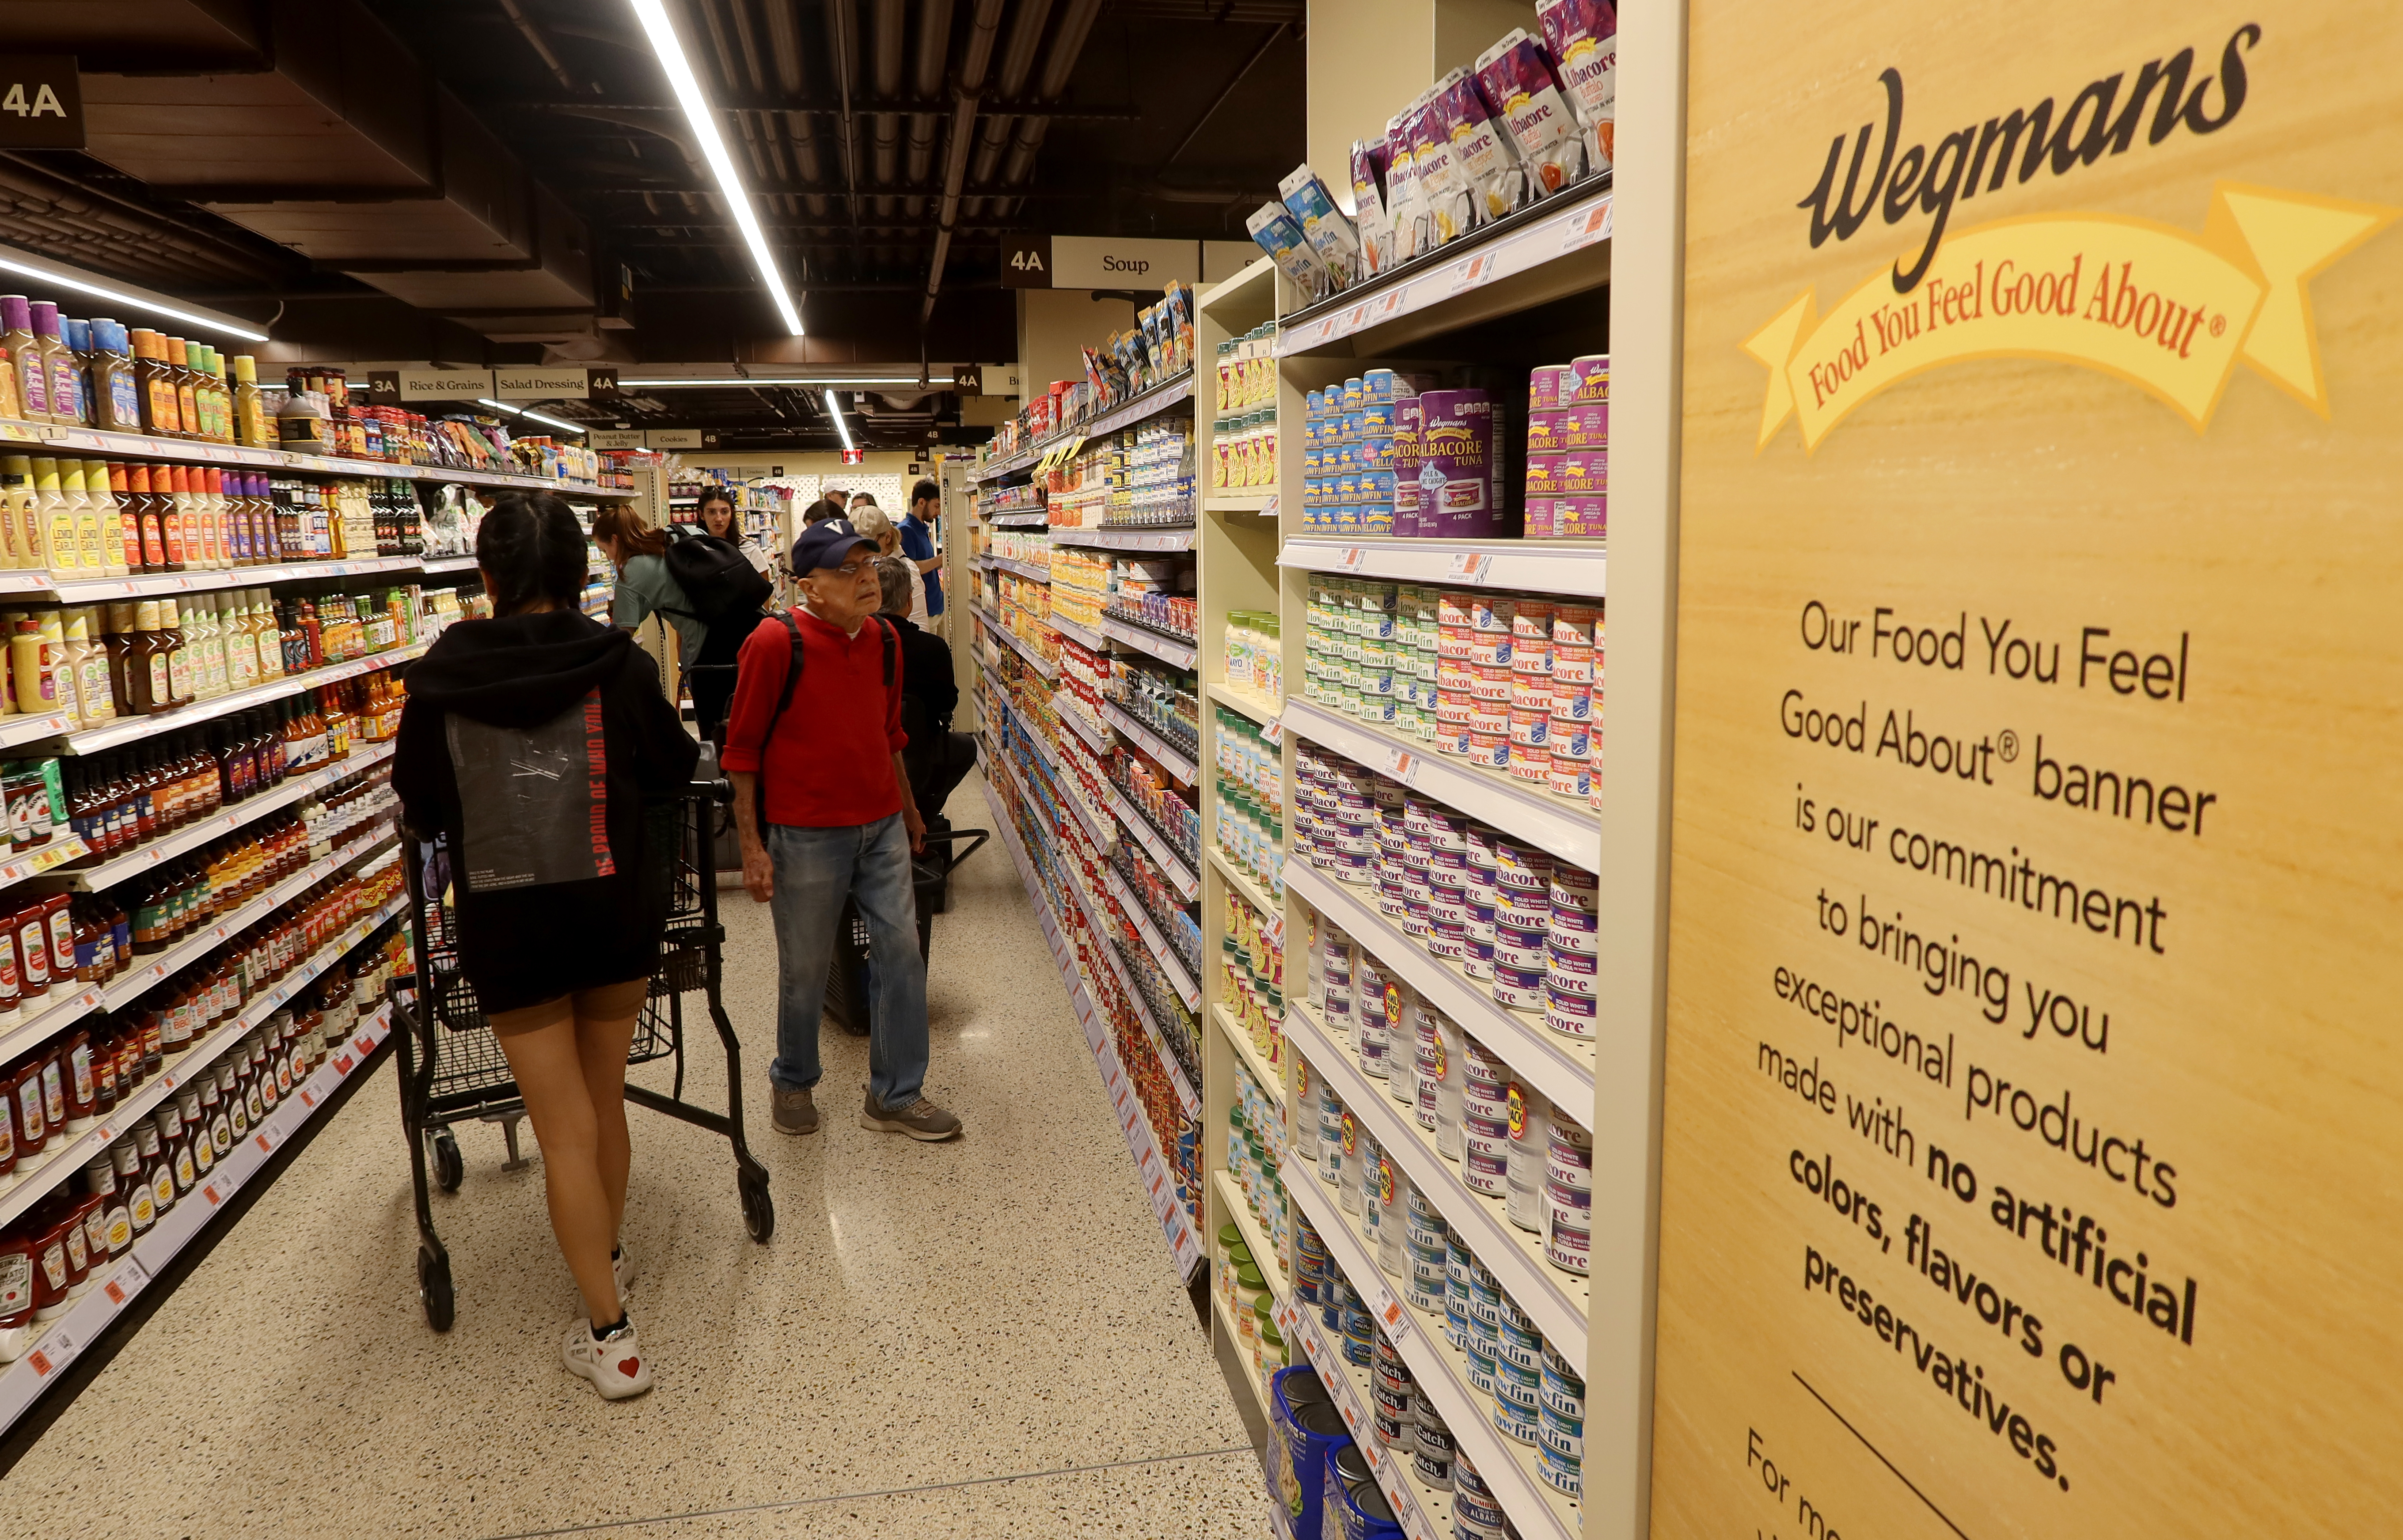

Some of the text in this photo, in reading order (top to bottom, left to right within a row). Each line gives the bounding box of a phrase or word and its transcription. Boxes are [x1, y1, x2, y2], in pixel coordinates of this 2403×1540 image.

[2, 83, 67, 118] 4A
[1797, 23, 2261, 294] Wegmans
[1011, 251, 1149, 275] 4A Soup
[1809, 319, 1869, 410] Food
[1871, 302, 1920, 356] You
[1927, 261, 1982, 332] Feel
[1992, 254, 2082, 316] Good
[1246, 342, 1255, 357] 1
[375, 377, 613, 392] 3A Rice & Grains Salad Dressing 4A
[959, 376, 977, 386] 4A
[48, 428, 53, 438] 1
[1430, 415, 1467, 428] Wegmans
[1420, 440, 1483, 457] ALBACORE
[1454, 455, 1483, 467] TUNA
[1802, 600, 2189, 702] Our Food You Feel
[584, 705, 604, 733] YOU
[587, 739, 607, 775] WHO
[1781, 689, 1865, 753] Good
[2034, 735, 2217, 836] banner
[589, 780, 607, 798] OF
[590, 804, 611, 853] PROUD
[1797, 783, 2167, 955] is our commitment
[1817, 888, 2108, 1054] to bringing you
[1386, 990, 1400, 1005] FAMILY
[1388, 1001, 1400, 1017] PACK
[1555, 1004, 1570, 1013] TUNA
[1556, 998, 1588, 1011] SOLID WHITE
[1774, 967, 2176, 1208] exceptional products
[1343, 1130, 1353, 1147] PACK
[1759, 1042, 2197, 1347] made with no artificial
[1790, 1149, 2116, 1405] colors, flavors or
[1377, 1359, 1406, 1382] Catch
[1506, 1373, 1518, 1383] TUNA
[1519, 1373, 1536, 1384] LIGHT
[1804, 1245, 2069, 1492] preservatives.
[1375, 1387, 1403, 1410] Catch
[1417, 1429, 1448, 1449] Catch
[1747, 1427, 1790, 1503] For
[1401, 1496, 1413, 1529] 499
[1470, 1497, 1498, 1509] BUMBLE
